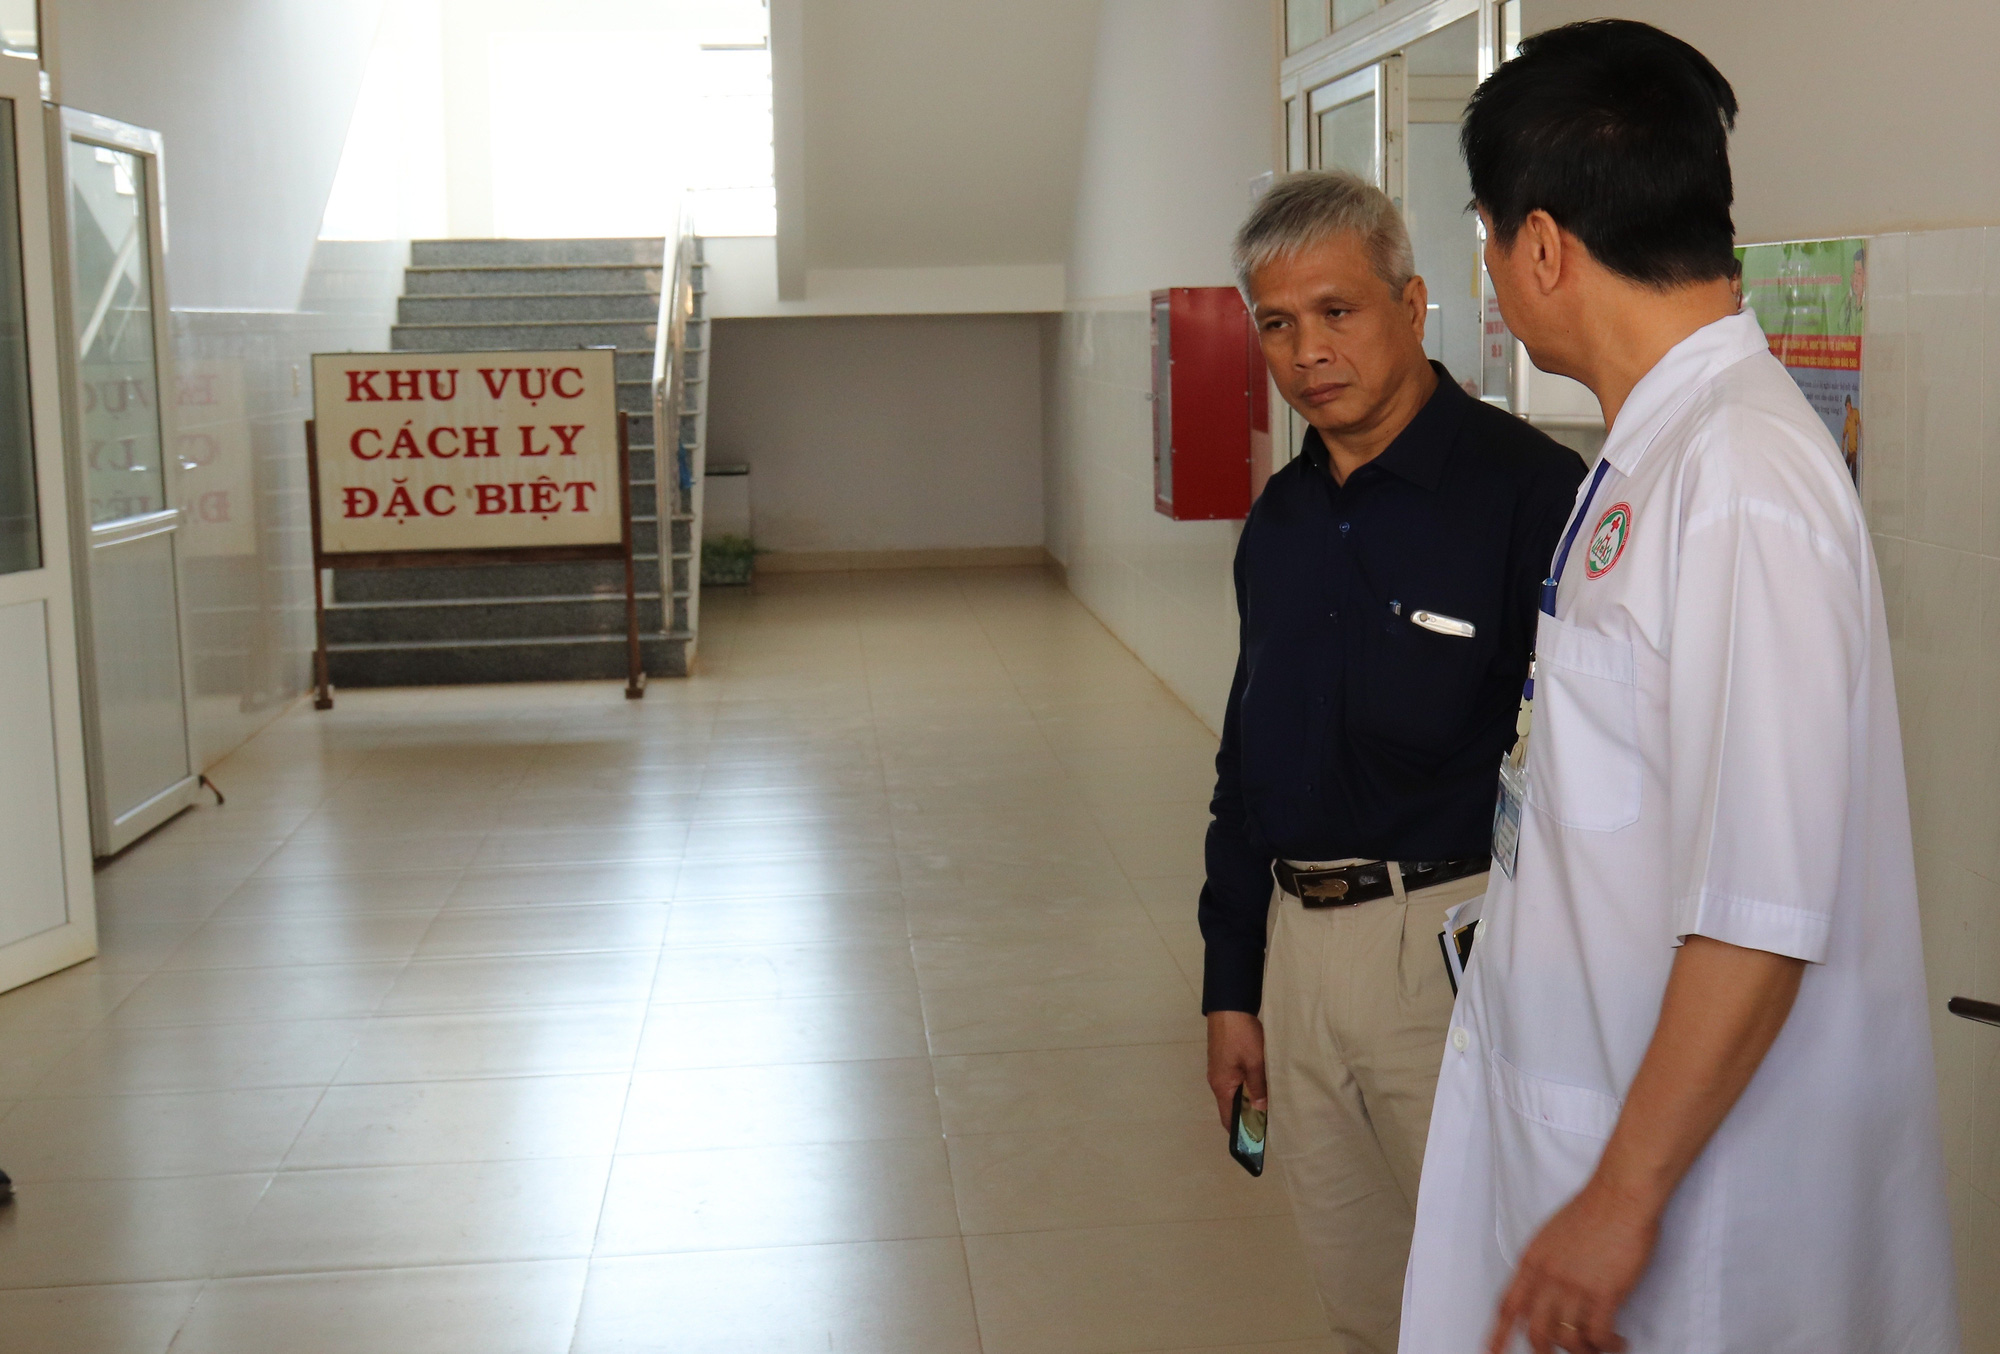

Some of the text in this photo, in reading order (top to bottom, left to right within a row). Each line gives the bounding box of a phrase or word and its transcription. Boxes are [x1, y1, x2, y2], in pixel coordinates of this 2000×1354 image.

[345, 367, 585, 407] KHU VỰC
[350, 420, 585, 461] CÁCH LY
[343, 475, 597, 525] ĐẶC BIỆT
